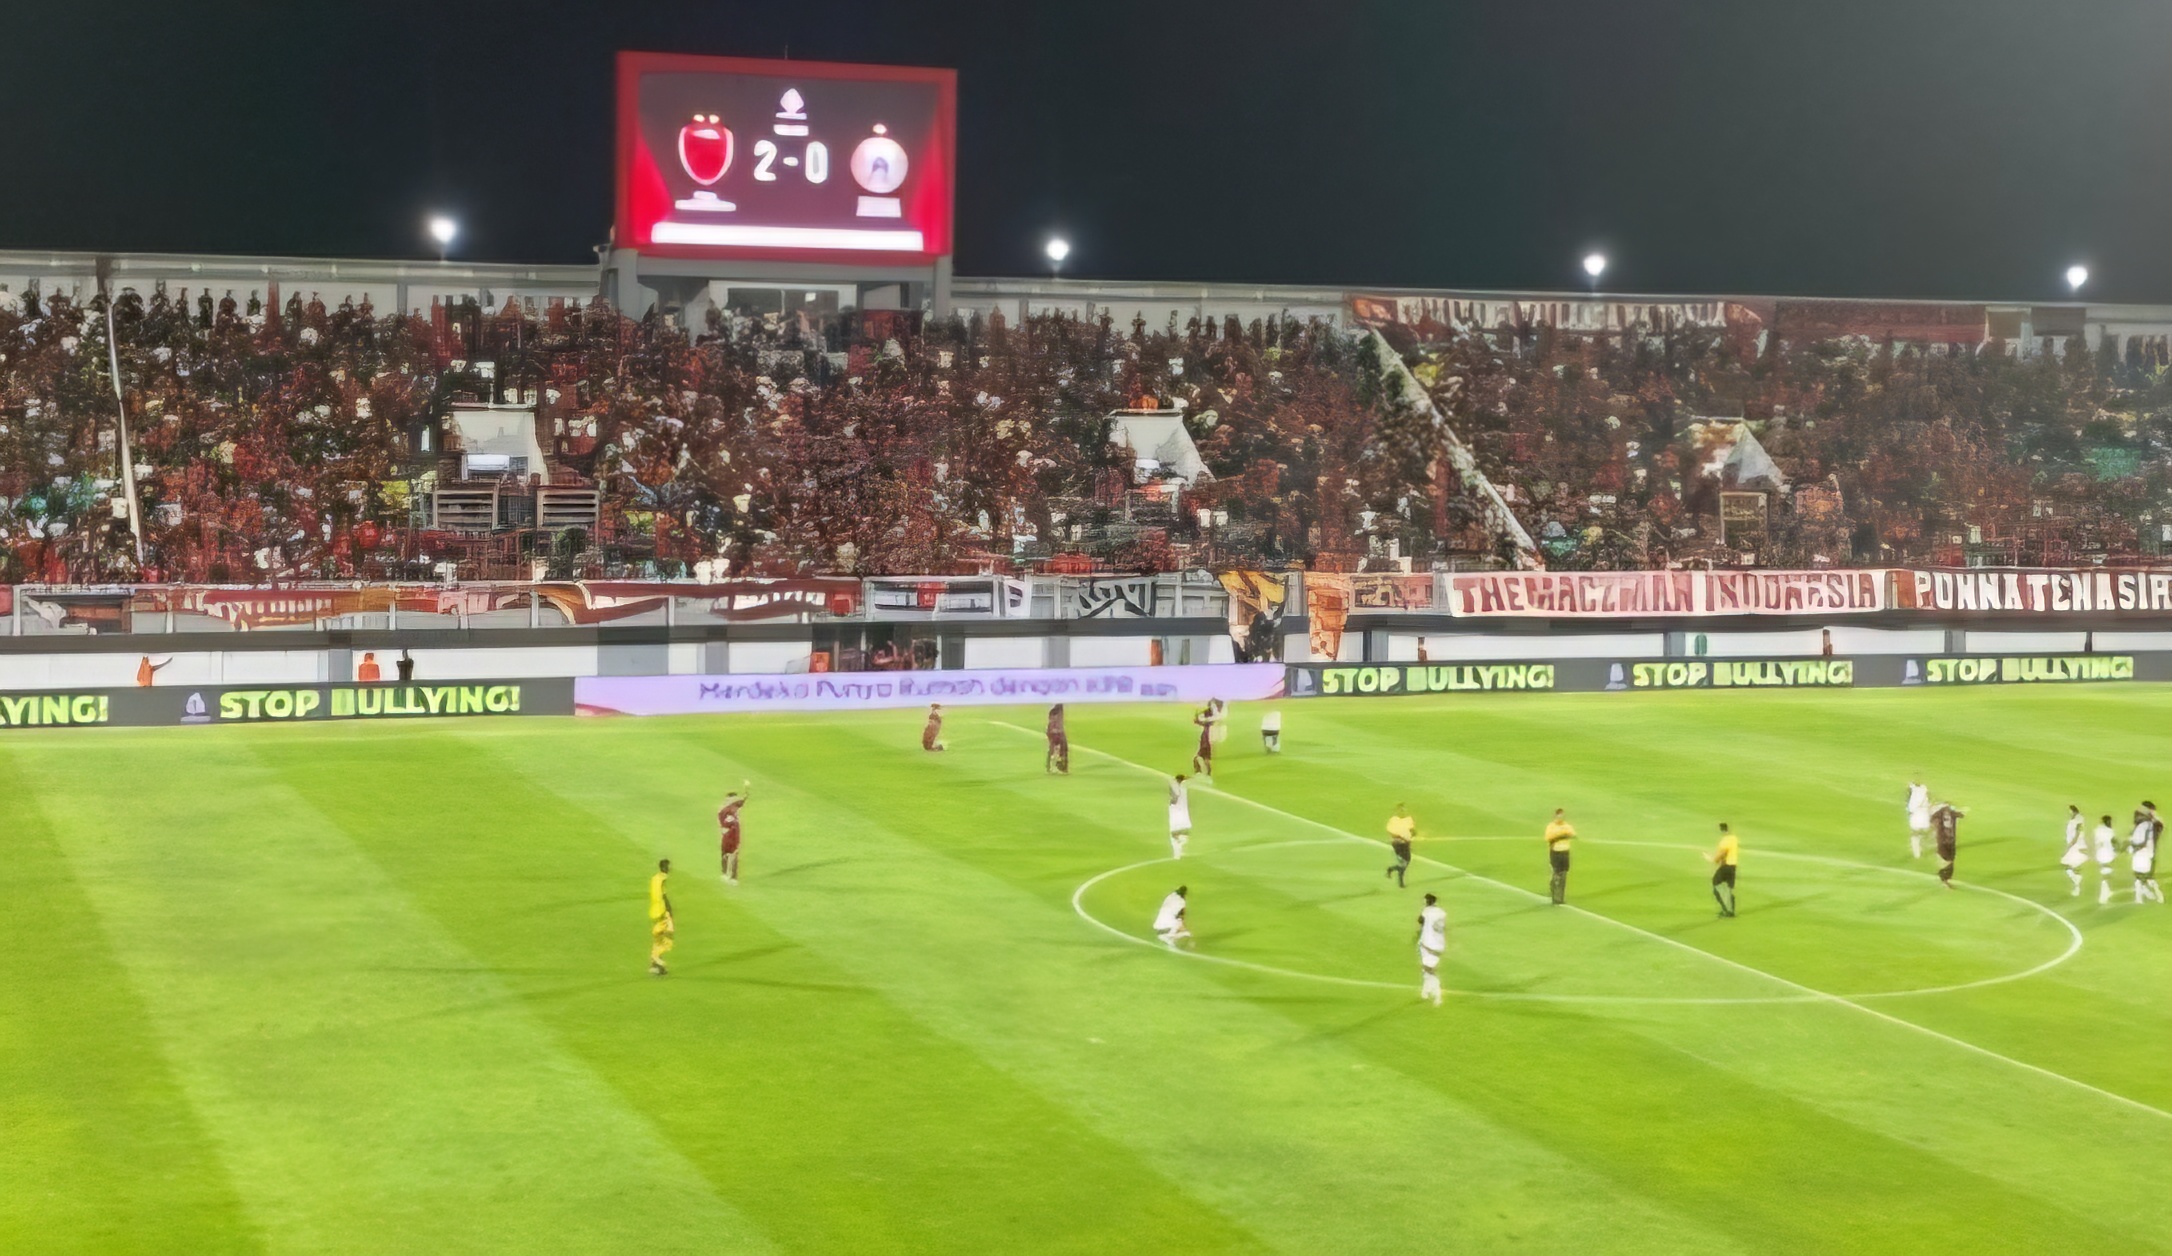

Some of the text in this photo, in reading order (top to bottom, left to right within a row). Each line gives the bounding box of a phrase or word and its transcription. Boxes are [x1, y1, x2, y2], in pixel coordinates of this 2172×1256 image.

[1322, 667, 1400, 693] STOP
[1632, 662, 1707, 687] STOP
[1926, 656, 2134, 683] STOP ULLYING
[0, 695, 108, 725] YING!
[220, 690, 320, 718] STOP
